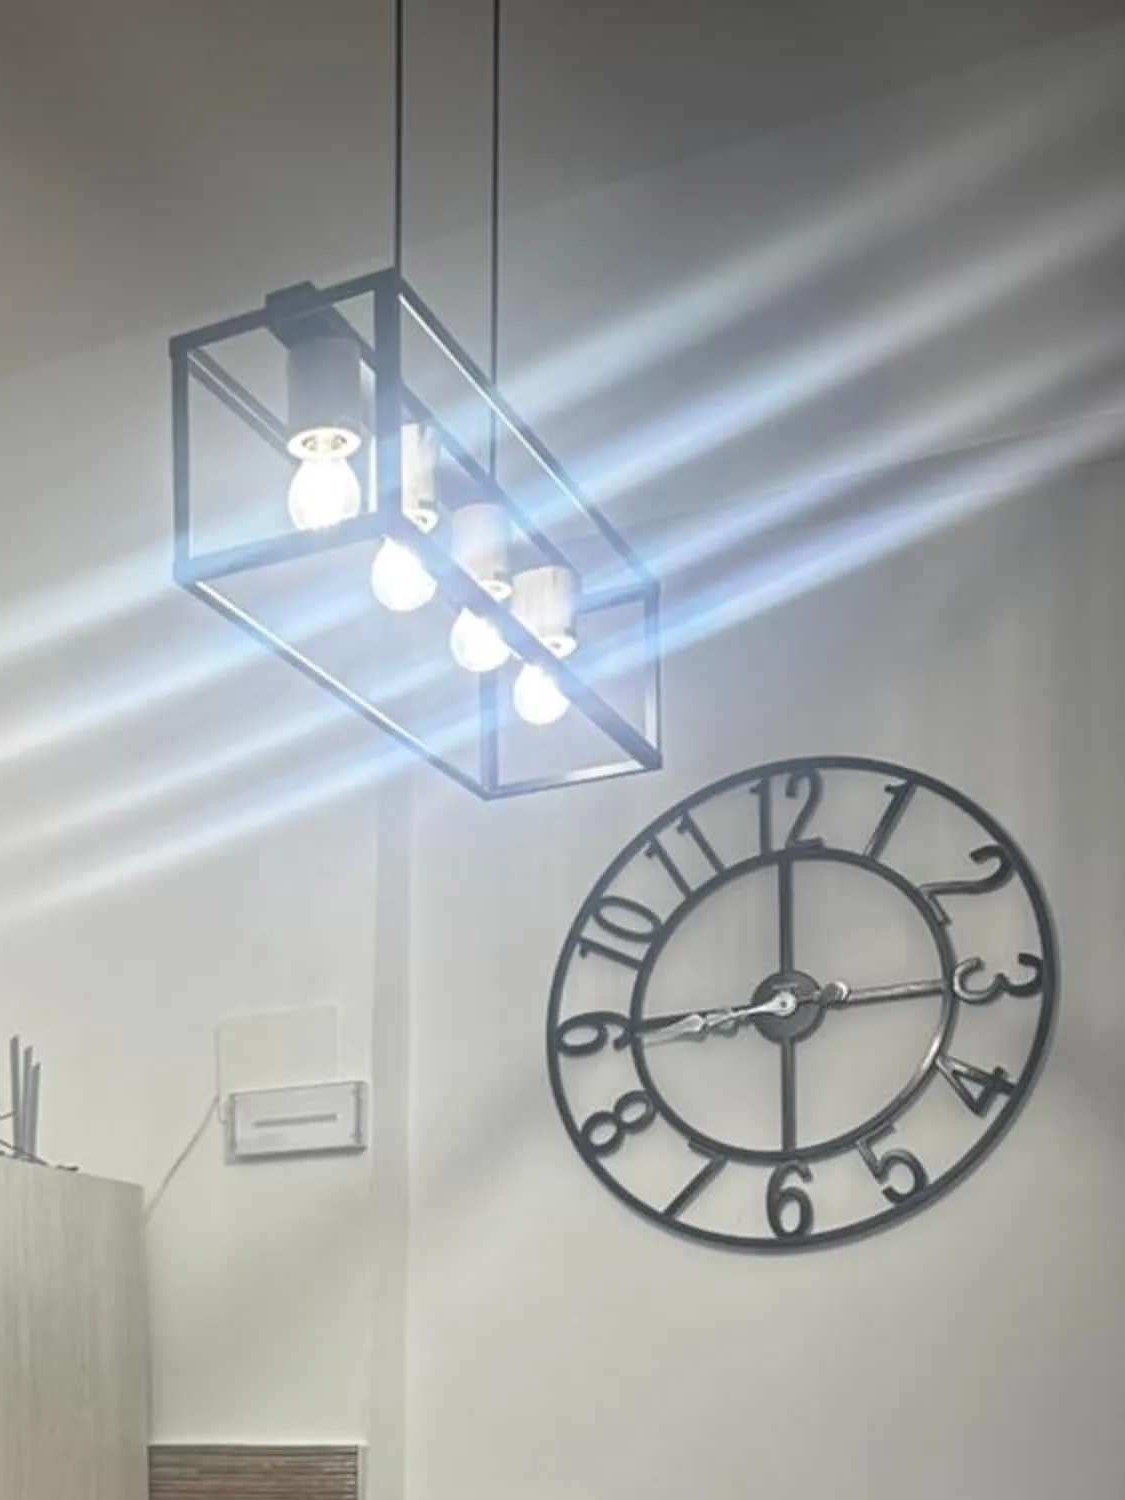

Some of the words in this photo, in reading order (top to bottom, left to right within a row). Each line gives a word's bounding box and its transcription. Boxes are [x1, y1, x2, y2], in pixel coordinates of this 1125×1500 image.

[750, 767, 825, 850] 12
[864, 778, 917, 858] 1
[644, 806, 725, 900] 11
[919, 844, 1015, 927] 2
[578, 894, 664, 970] 10
[951, 953, 1045, 1006] 3
[554, 1011, 636, 1056] 9
[580, 1090, 660, 1155] 8
[933, 1055, 1015, 1117] 4
[660, 1136, 729, 1220] 7
[766, 1158, 814, 1240] 6
[853, 1121, 930, 1204] 5
